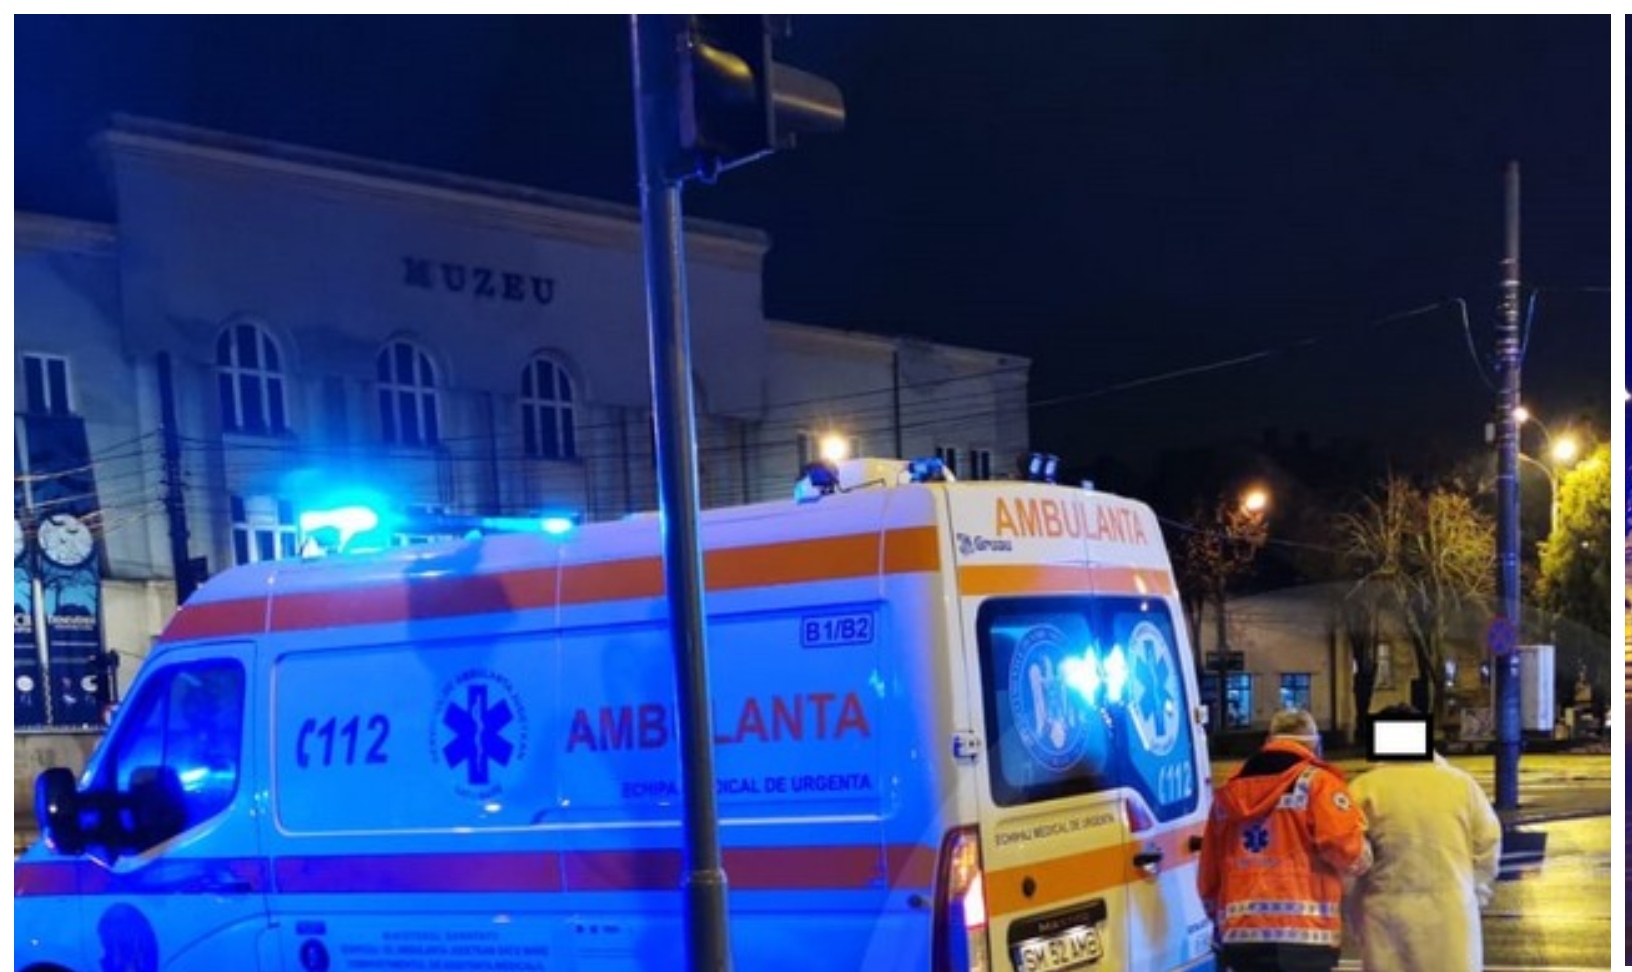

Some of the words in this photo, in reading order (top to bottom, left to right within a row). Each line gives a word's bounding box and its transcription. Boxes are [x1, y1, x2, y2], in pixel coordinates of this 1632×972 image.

[402, 256, 555, 305] MUZEU
[996, 496, 1149, 546] AMBULANTA
[805, 617, 870, 642] B1/B2
[317, 713, 391, 767] 112
[763, 776, 786, 794] DE
[790, 772, 871, 793] URGENTA
